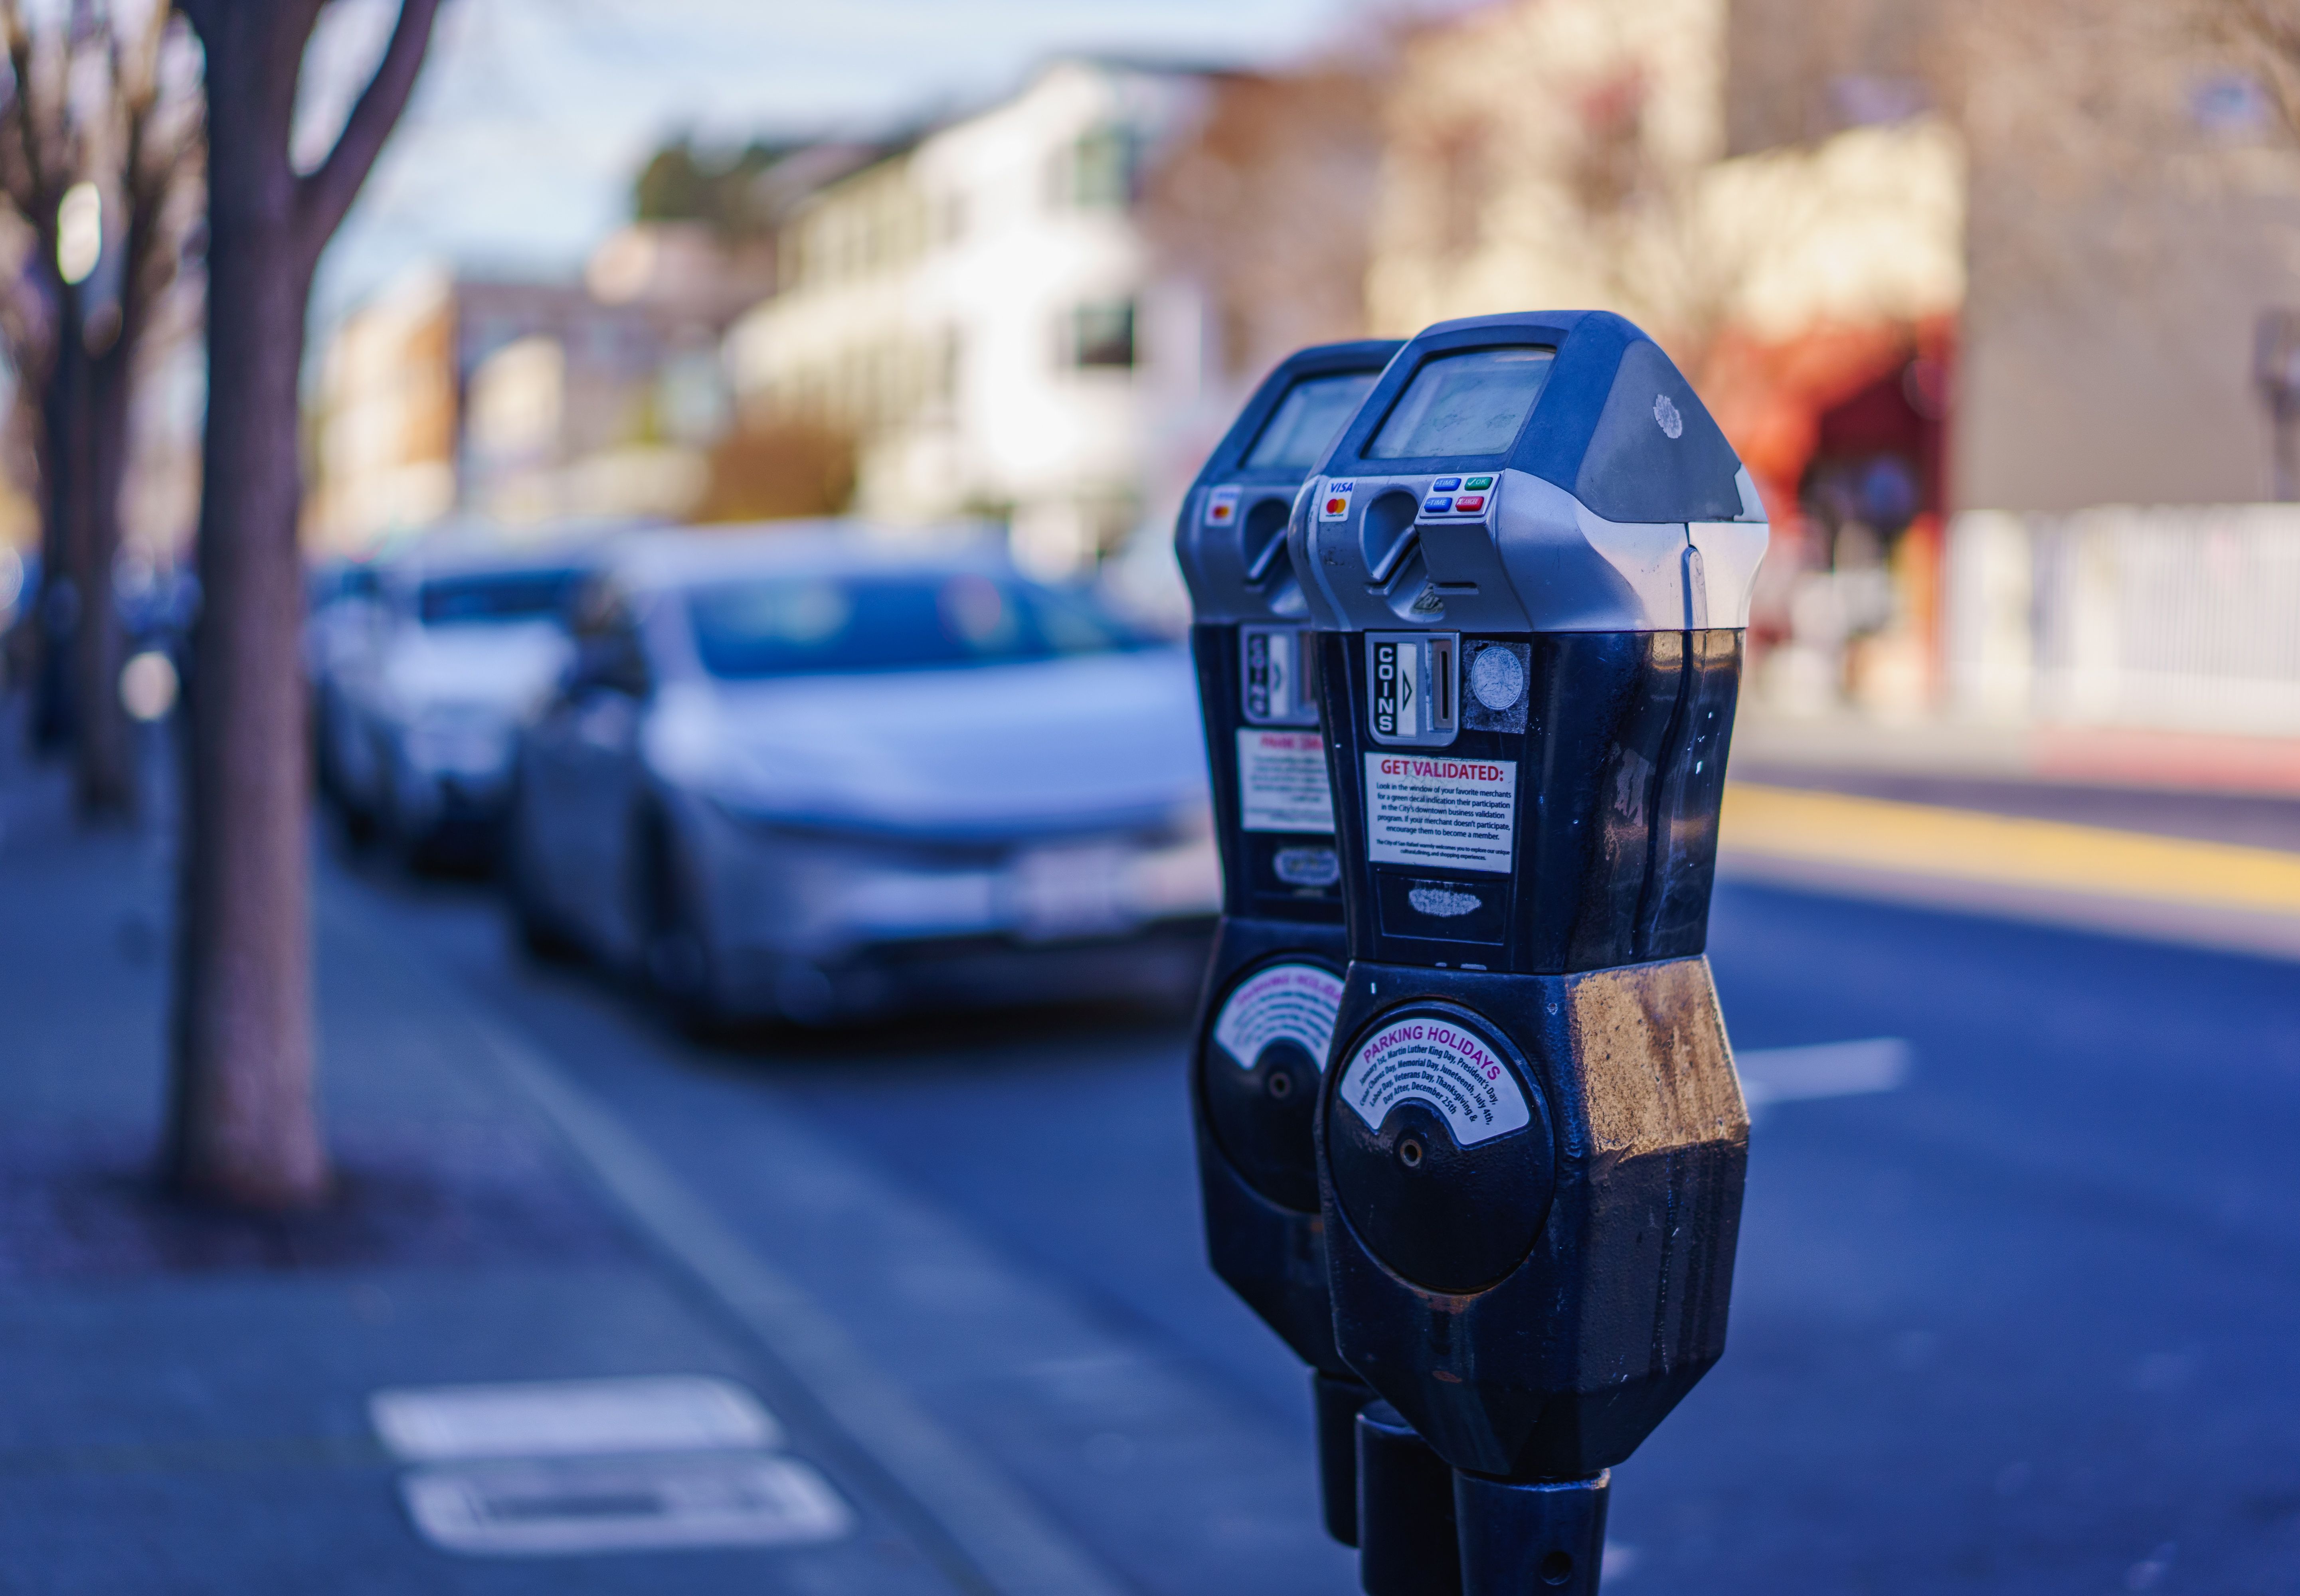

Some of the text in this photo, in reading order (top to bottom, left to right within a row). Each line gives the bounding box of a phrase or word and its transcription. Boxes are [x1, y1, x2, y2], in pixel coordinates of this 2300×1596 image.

[1331, 482, 1353, 493] VISA
[1378, 647, 1393, 731] COINS
[1381, 759, 1503, 782] GET VALIDATED:
[1456, 787, 1478, 796] favorite
[1399, 804, 1414, 813] City's
[1415, 806, 1447, 814] downtown
[1475, 810, 1505, 819] validation
[1472, 799, 1510, 809] participation
[1386, 826, 1417, 835] encourage
[1443, 829, 1467, 837] become
[1477, 822, 1510, 831] participate,
[1363, 1026, 1500, 1080] PARKING HOLIDAYS
[1359, 1063, 1377, 1086] January
[1387, 1047, 1406, 1059] Martin
[1407, 1045, 1428, 1053] Luther
[1428, 1045, 1443, 1059] King
[1443, 1050, 1456, 1064] Day,
[1457, 1058, 1489, 1089] President's
[1486, 1087, 1498, 1105] Day,
[1369, 1071, 1385, 1089] Chavez
[1385, 1064, 1396, 1074] Day,
[1398, 1058, 1426, 1068] Memorial
[1426, 1059, 1439, 1071] Day,
[1440, 1064, 1474, 1096] Juneteenth,
[1473, 1093, 1486, 1109] July
[1483, 1108, 1493, 1125] 4th,
[1370, 1088, 1382, 1107] Labor
[1382, 1079, 1394, 1090] Day,
[1394, 1072, 1420, 1082] Veterans
[1422, 1071, 1434, 1083] Day,
[1436, 1075, 1473, 1116] Thanksgiving
[1383, 1082, 1457, 1114] Day After, December 25th
